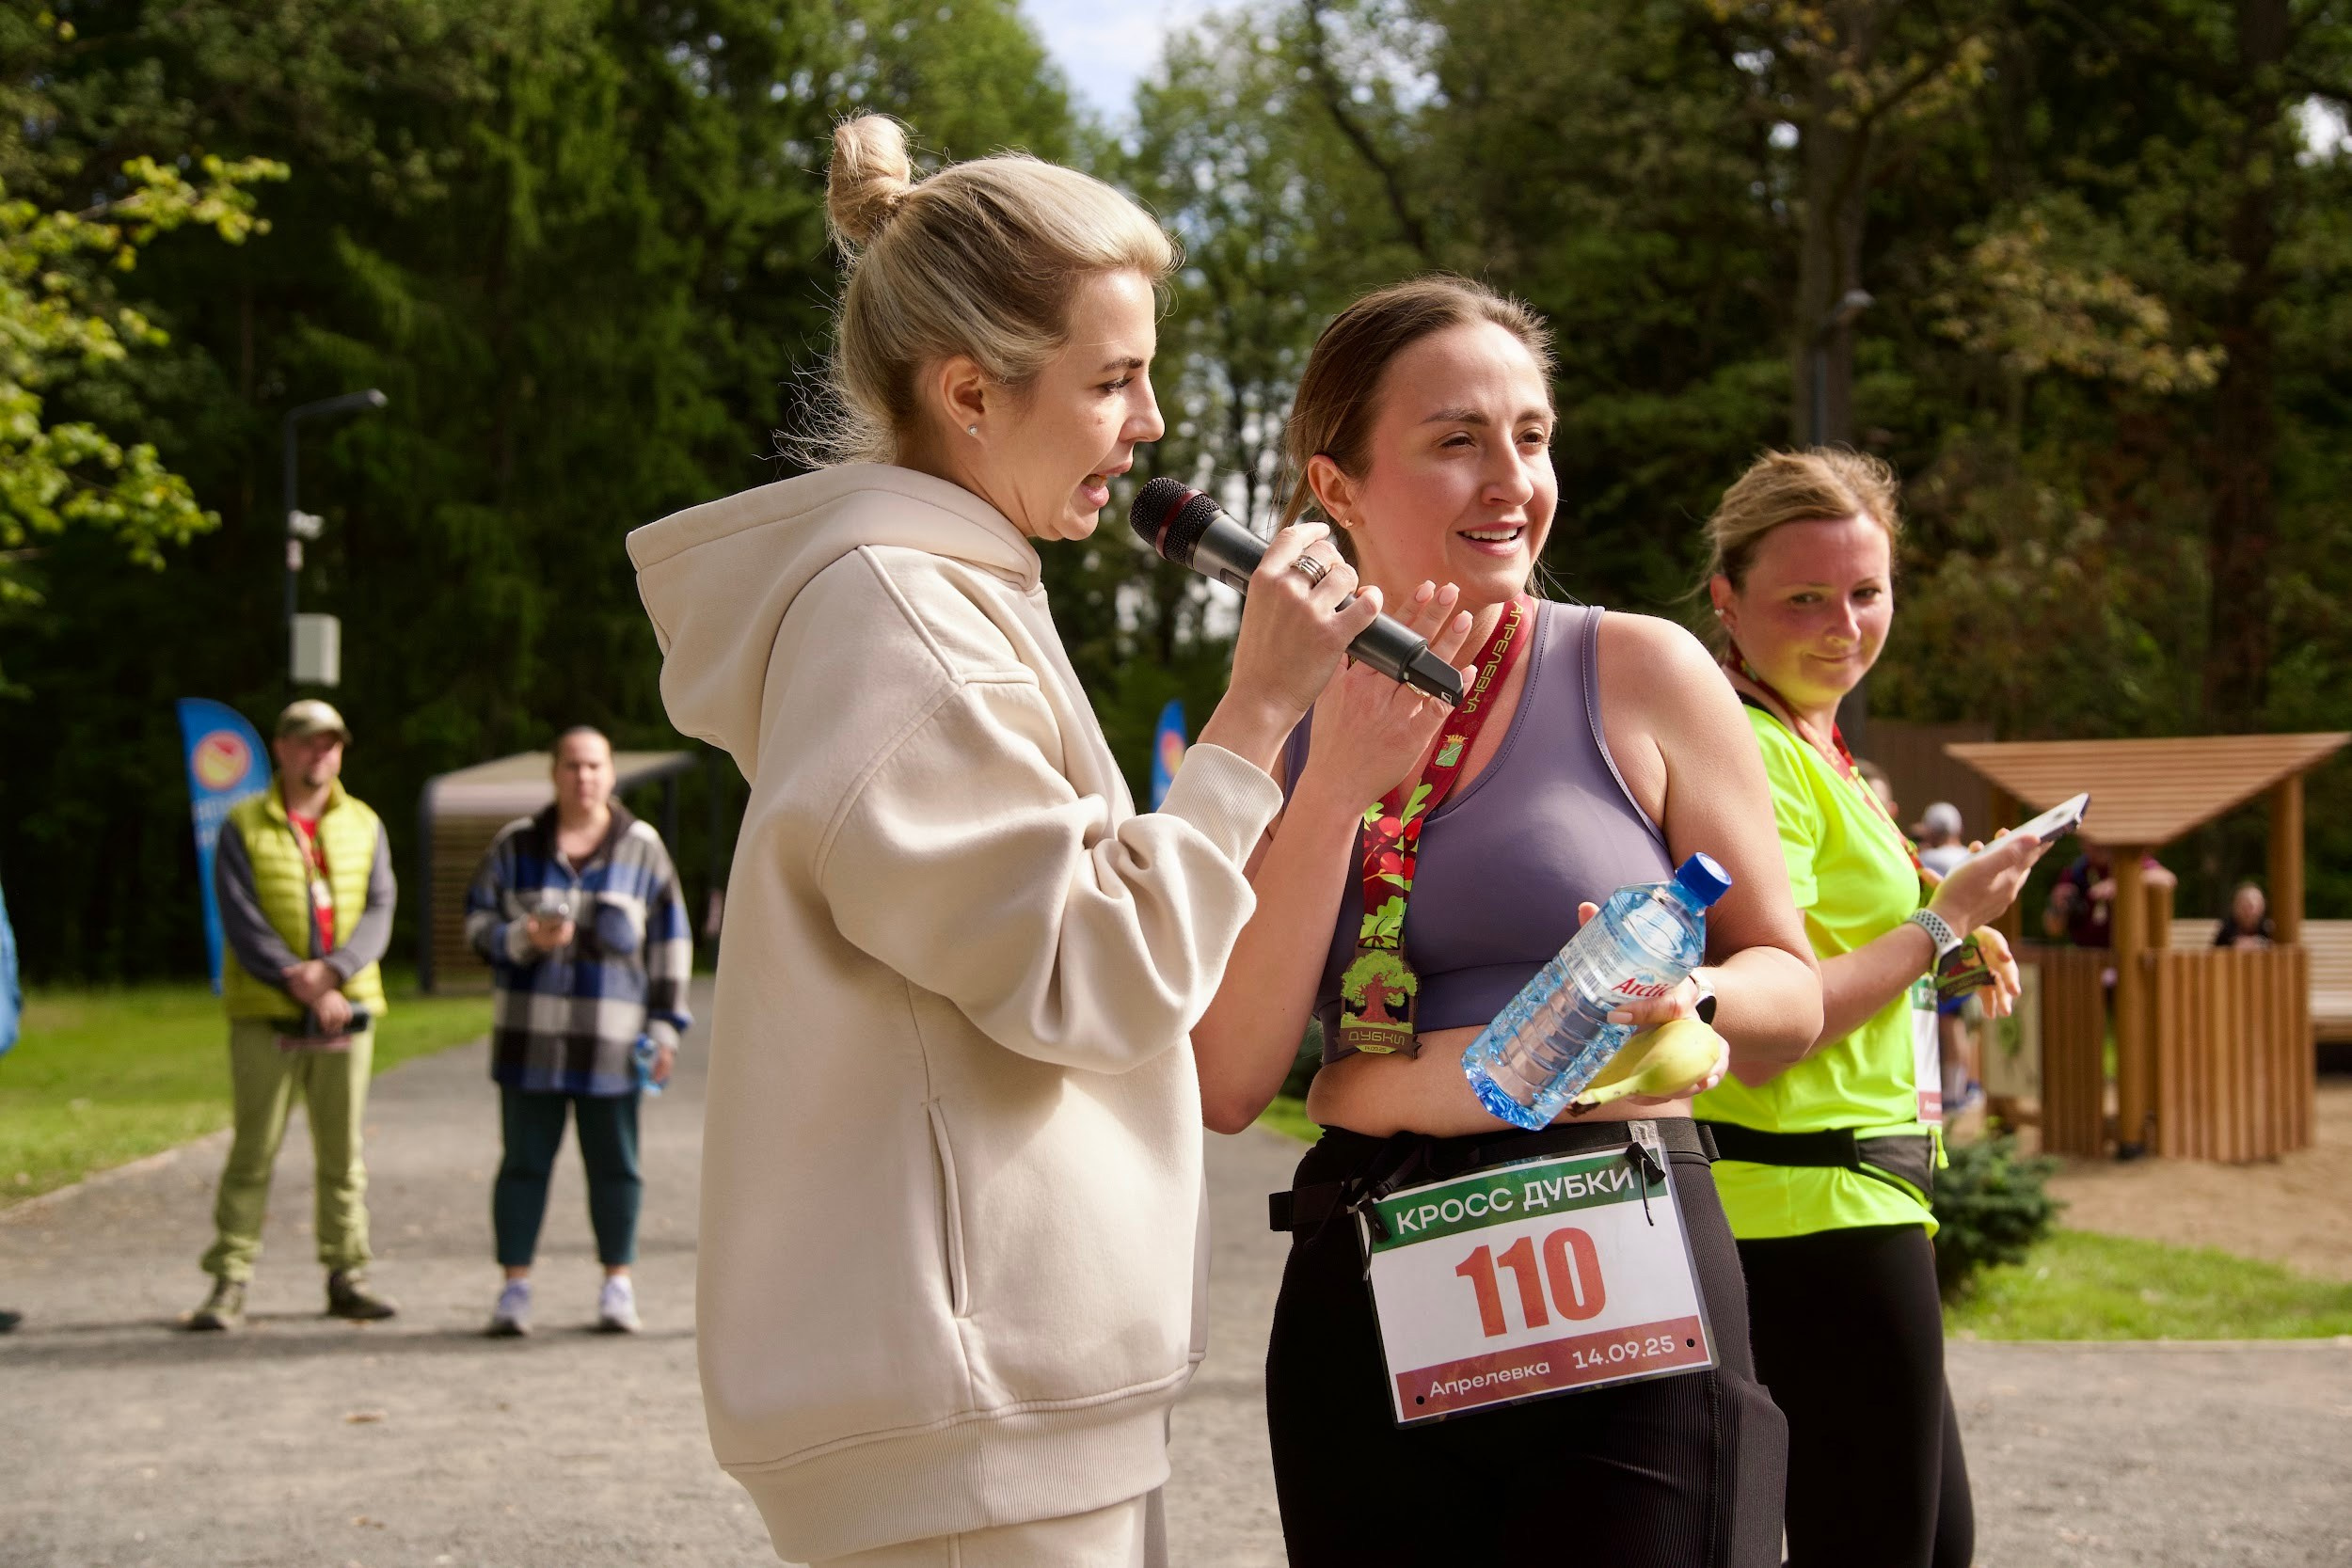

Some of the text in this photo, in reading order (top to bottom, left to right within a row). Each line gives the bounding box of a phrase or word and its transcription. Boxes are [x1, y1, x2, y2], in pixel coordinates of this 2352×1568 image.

[1462, 600, 1524, 714] АПРЕЛЕВКА
[1348, 1031, 1406, 1046] ДУБКИ
[1396, 1166, 1635, 1235] КРОСС ДУБКИ
[1454, 1227, 1606, 1338] 110
[1429, 1335, 1676, 1398] Апрелевка 14.09.25
